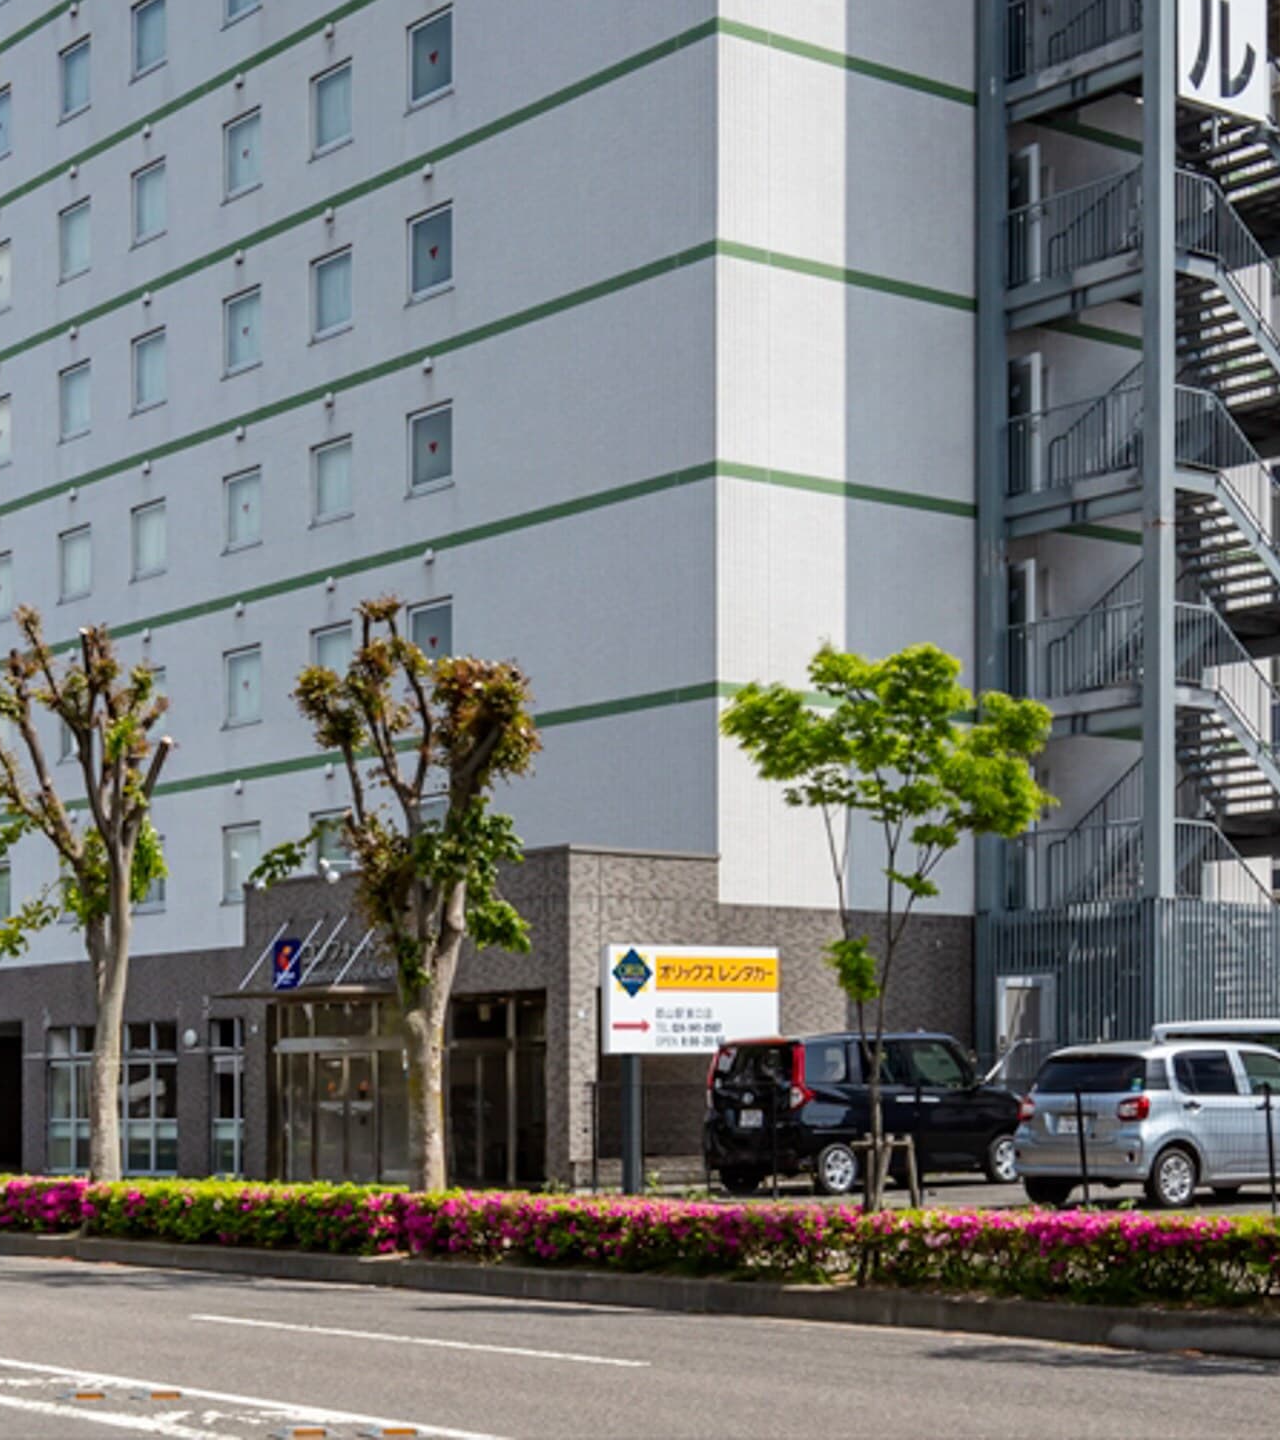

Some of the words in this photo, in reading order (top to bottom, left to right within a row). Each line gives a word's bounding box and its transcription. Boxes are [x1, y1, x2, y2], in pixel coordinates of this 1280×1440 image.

[658, 964, 715, 982] オリックス
[718, 965, 774, 982] レンタカー
